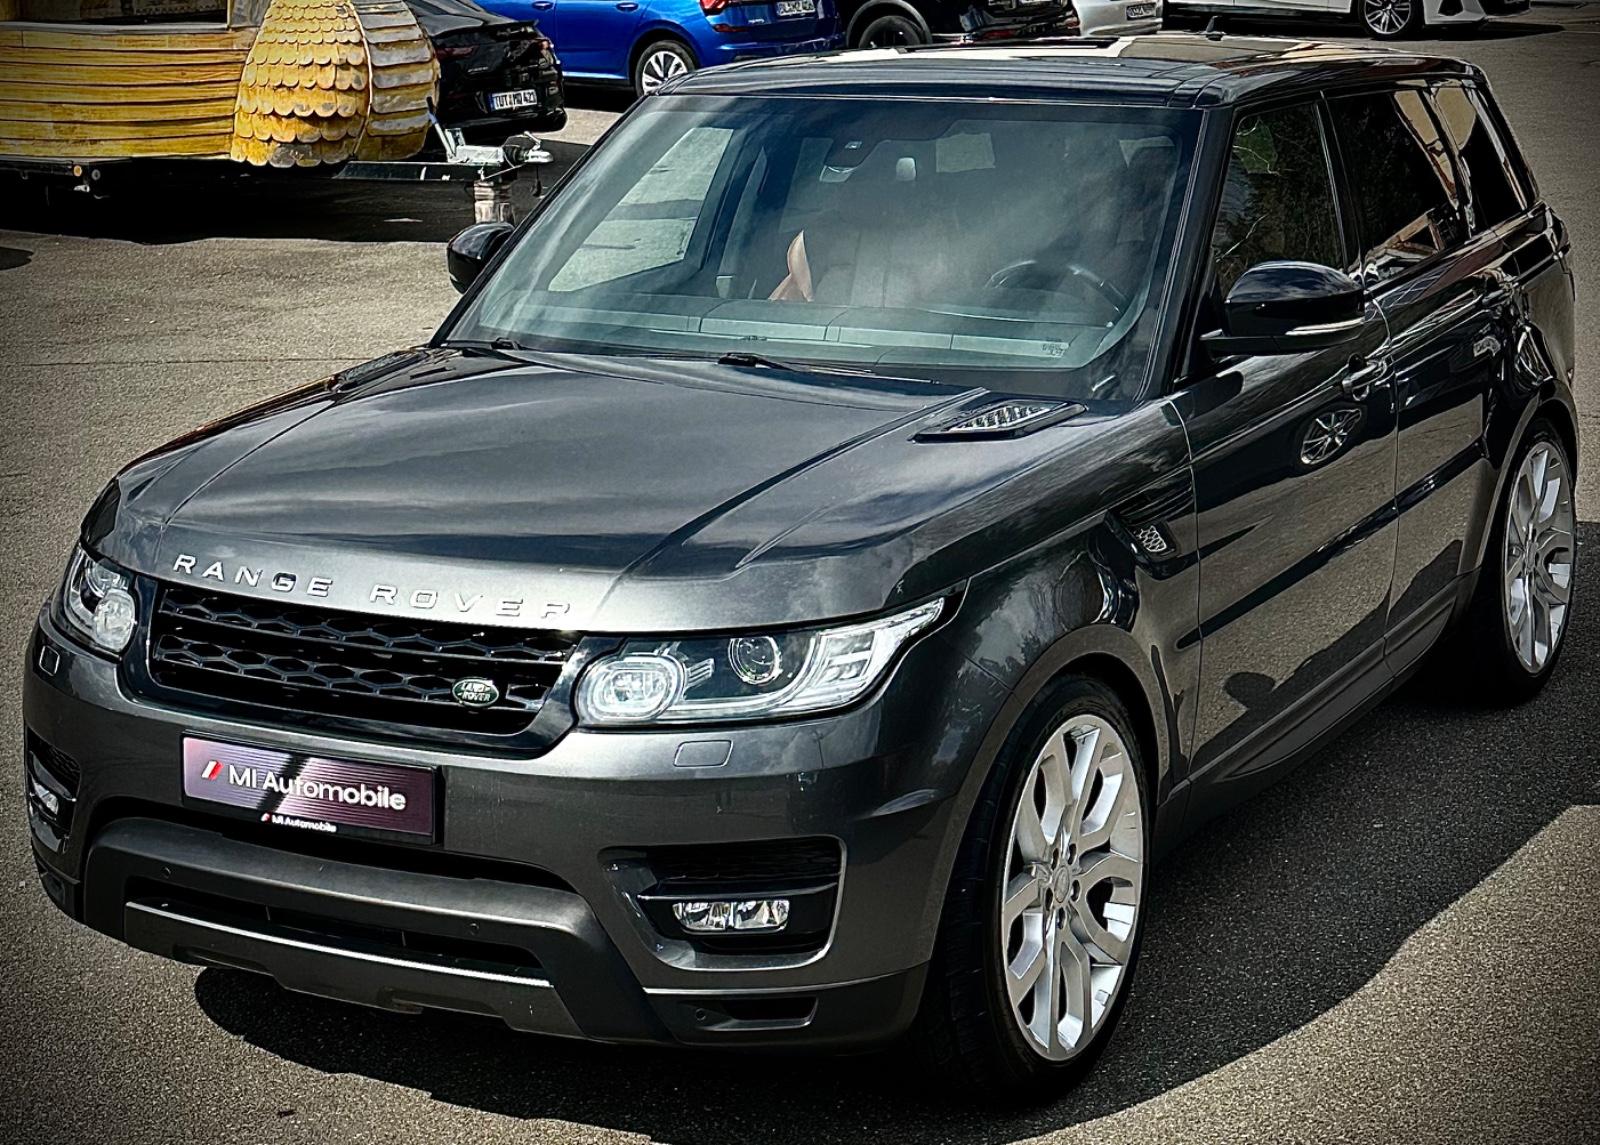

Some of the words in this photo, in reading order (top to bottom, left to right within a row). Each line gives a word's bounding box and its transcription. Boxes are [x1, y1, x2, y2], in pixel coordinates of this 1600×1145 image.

[172, 553, 333, 598] RANGE
[369, 584, 572, 620] ROVER
[462, 691, 491, 702] ROVER
[228, 764, 257, 789] MI
[262, 775, 407, 811] Automobile
[271, 814, 284, 825] MI
[284, 816, 337, 833] Automobile
